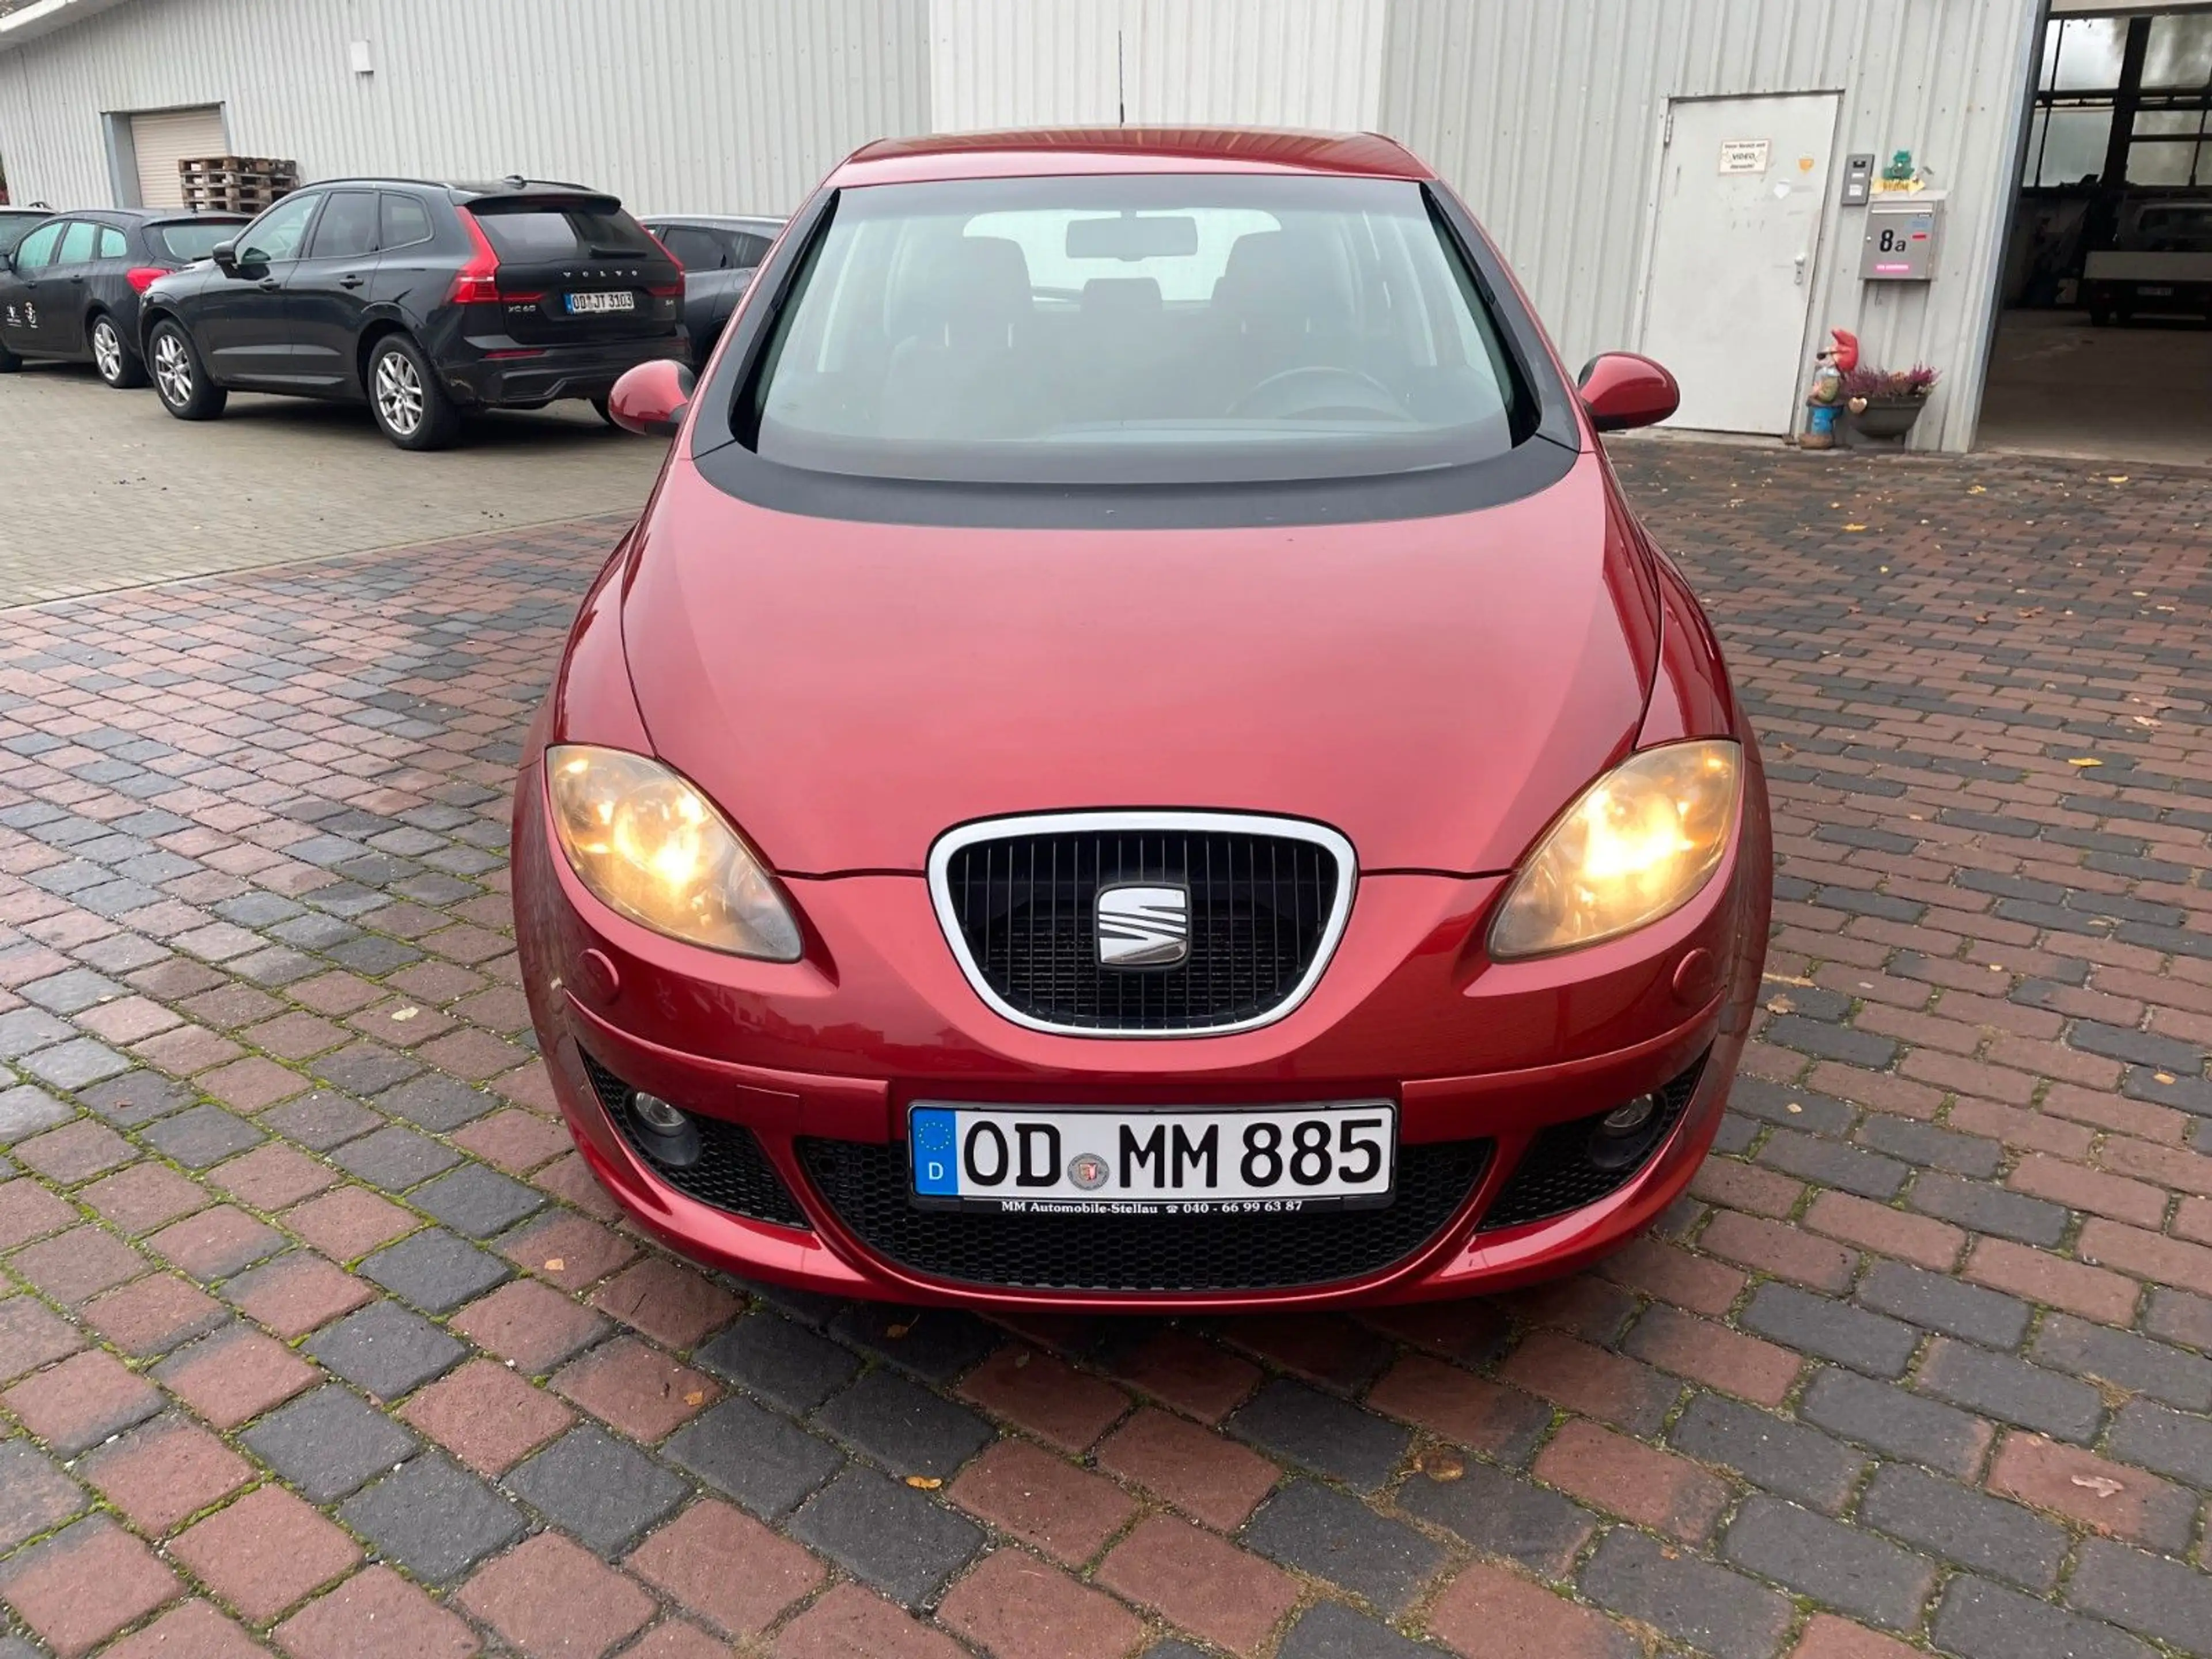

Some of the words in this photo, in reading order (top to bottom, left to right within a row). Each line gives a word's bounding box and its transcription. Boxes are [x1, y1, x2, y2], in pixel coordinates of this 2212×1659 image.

[608, 294, 632, 308] 3103
[929, 1162, 943, 1180] D
[964, 1120, 1061, 1187] OD
[1119, 1124, 1218, 1188] MM
[1240, 1119, 1382, 1187] 885
[1002, 1201, 1026, 1212] MM
[1031, 1202, 1158, 1214] Automobile-Stellau
[1183, 1202, 1209, 1213] 040
[1222, 1202, 1238, 1213] 66
[1243, 1202, 1260, 1212] 99
[1264, 1201, 1281, 1212] 63
[1285, 1200, 1302, 1211] 87
